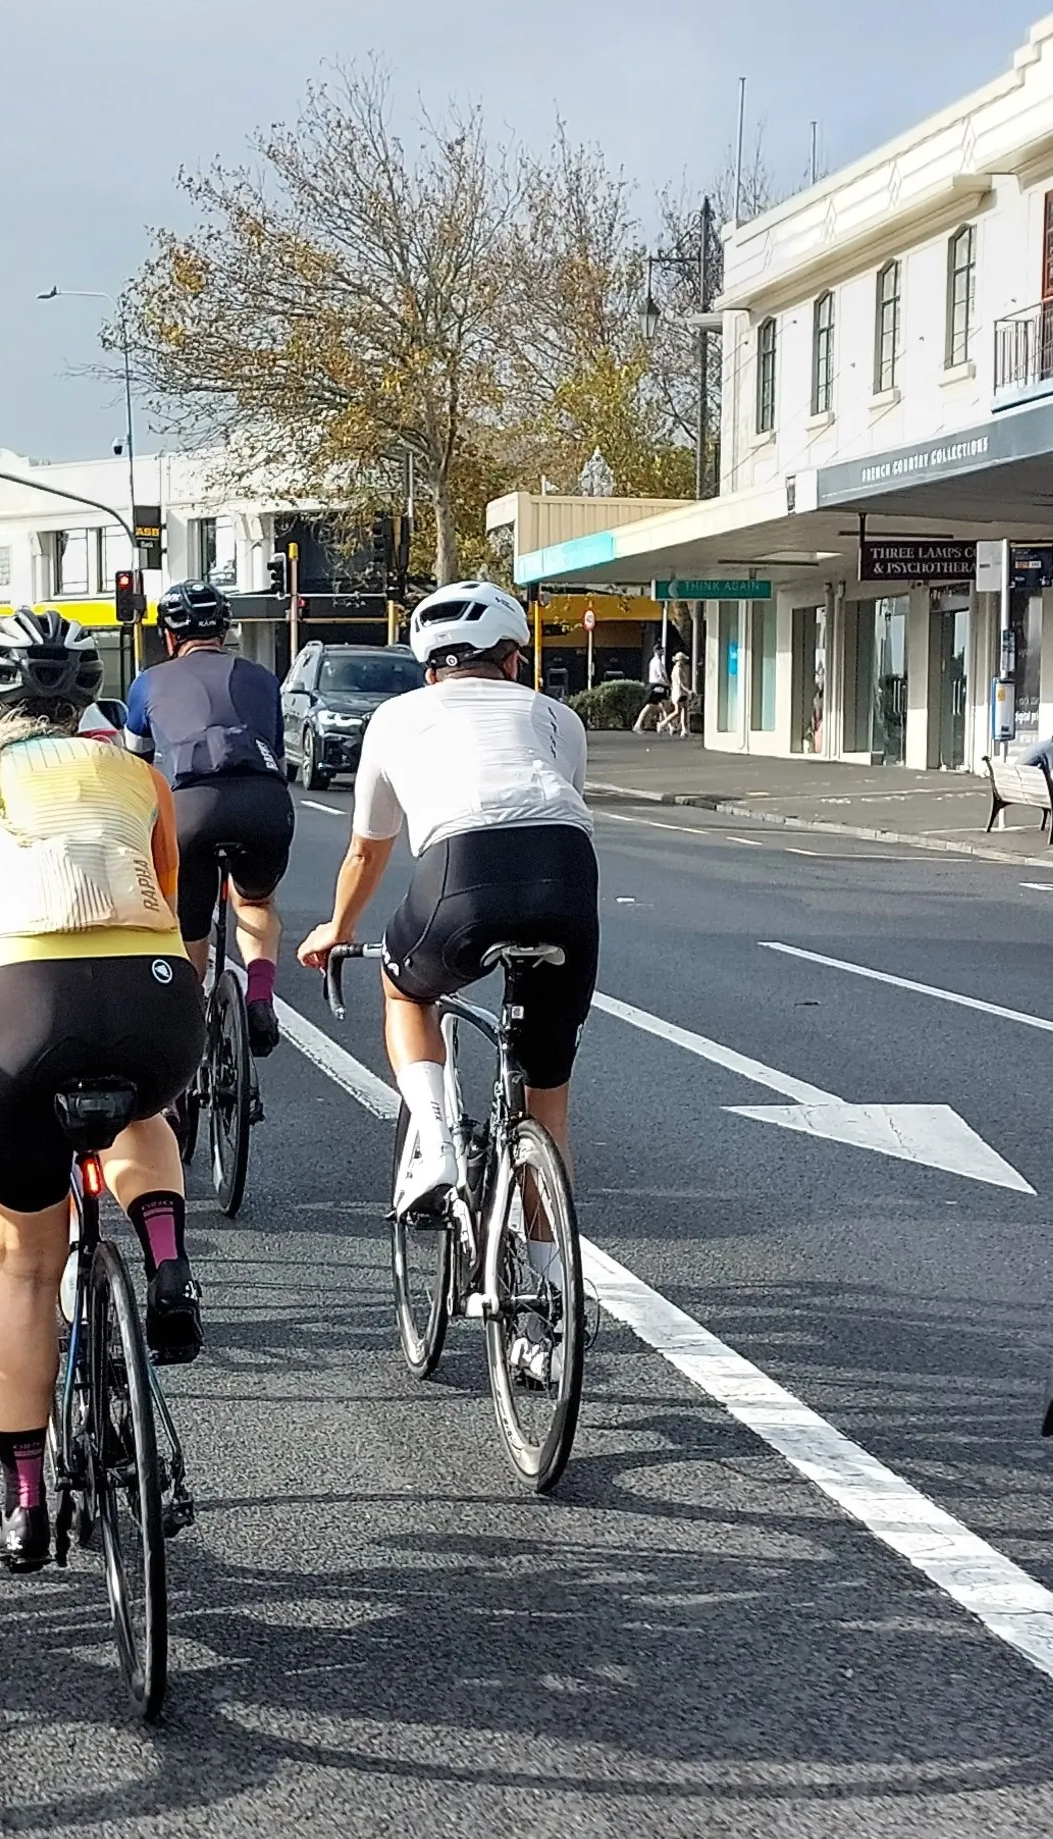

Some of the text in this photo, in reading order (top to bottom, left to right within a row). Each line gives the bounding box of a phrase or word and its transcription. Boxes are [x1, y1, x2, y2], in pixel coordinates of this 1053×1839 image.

[862, 436, 989, 482] FRENCH COUNTRY COLLECTIONS
[135, 526, 160, 537] ASB
[870, 547, 977, 559] THREE LAMPS C
[873, 562, 884, 574] &
[685, 581, 760, 592] THINK AGAIN
[134, 859, 160, 911] RAPHA
